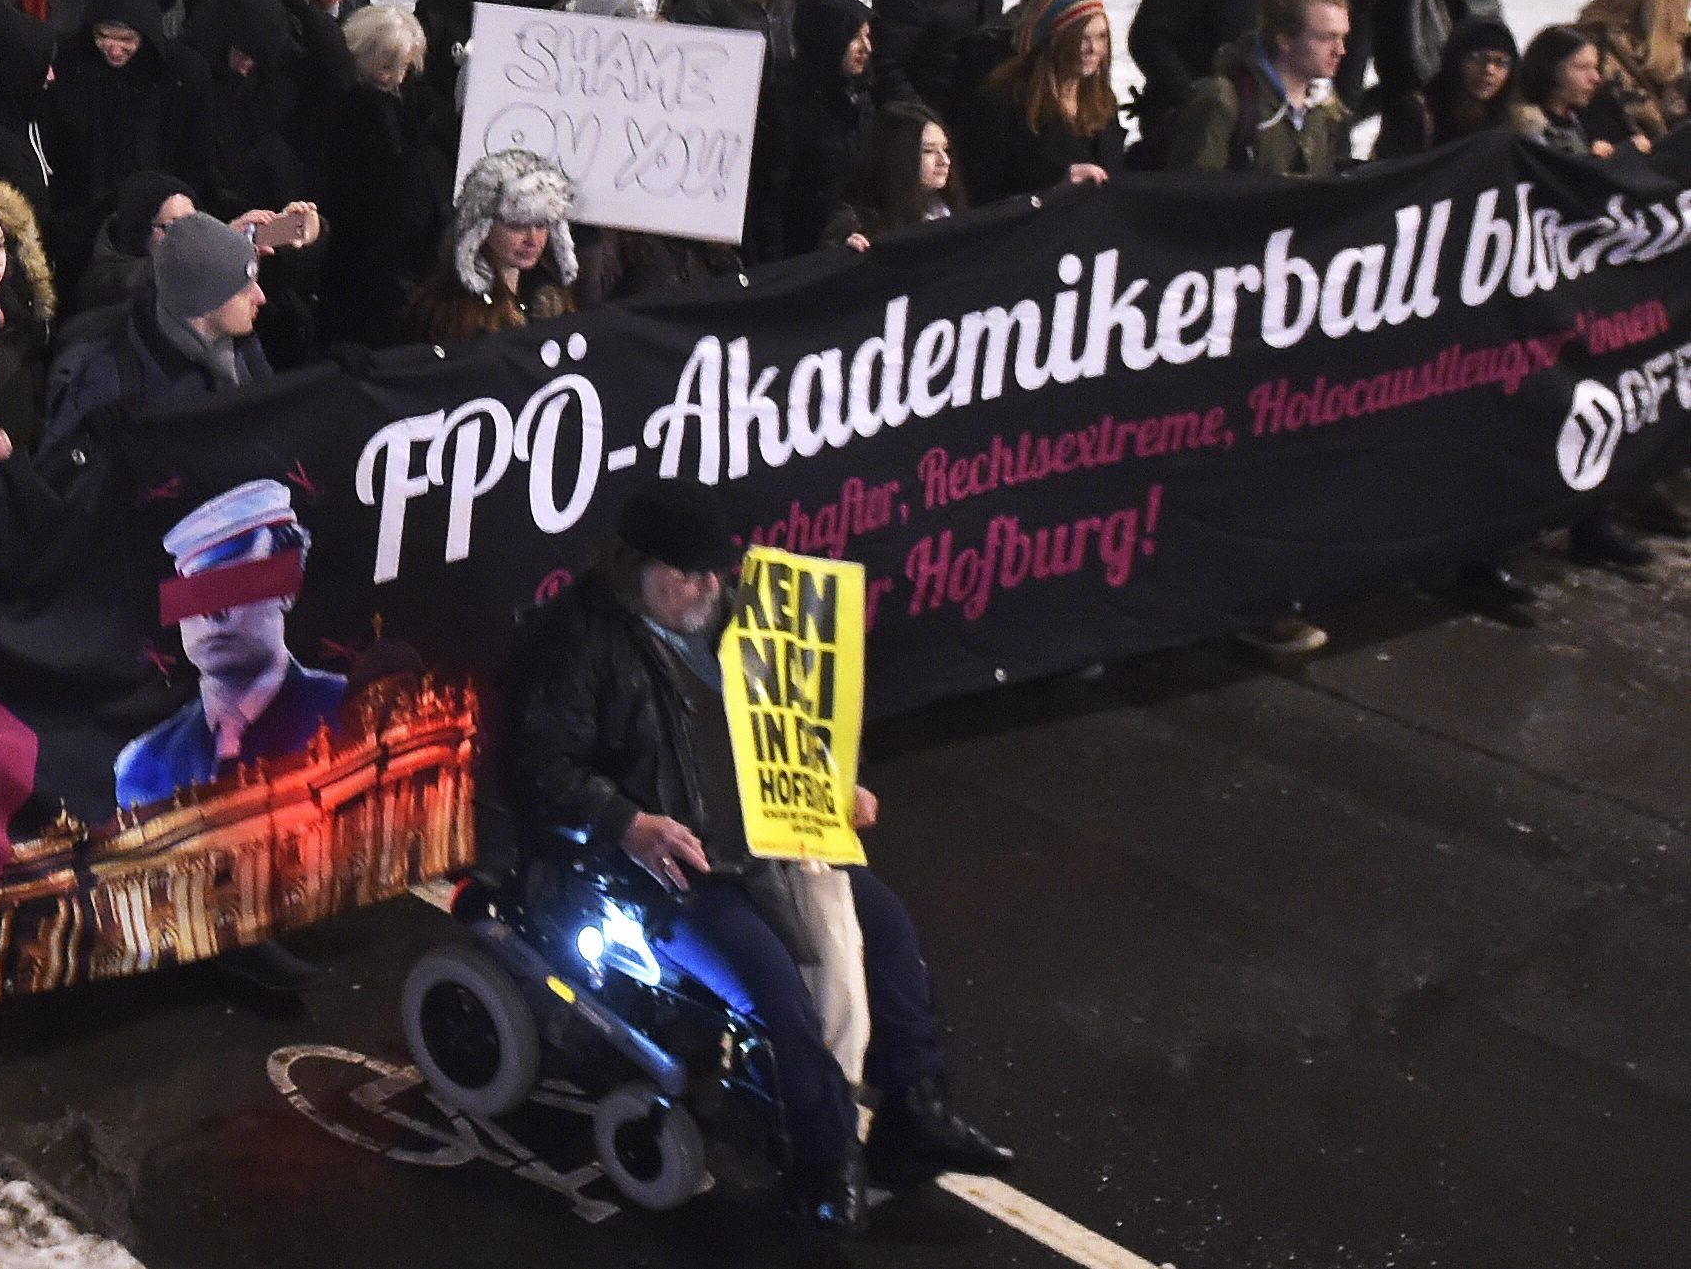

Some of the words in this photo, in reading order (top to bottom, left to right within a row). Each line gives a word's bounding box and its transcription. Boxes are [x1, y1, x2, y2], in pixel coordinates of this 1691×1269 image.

[504, 20, 730, 112] SHAME
[356, 198, 1451, 584] FPÖ-Akademikerball
[917, 405, 1235, 509] Rechtsextreme,
[906, 485, 1164, 621] Hofburg!
[751, 710, 790, 764] IN
